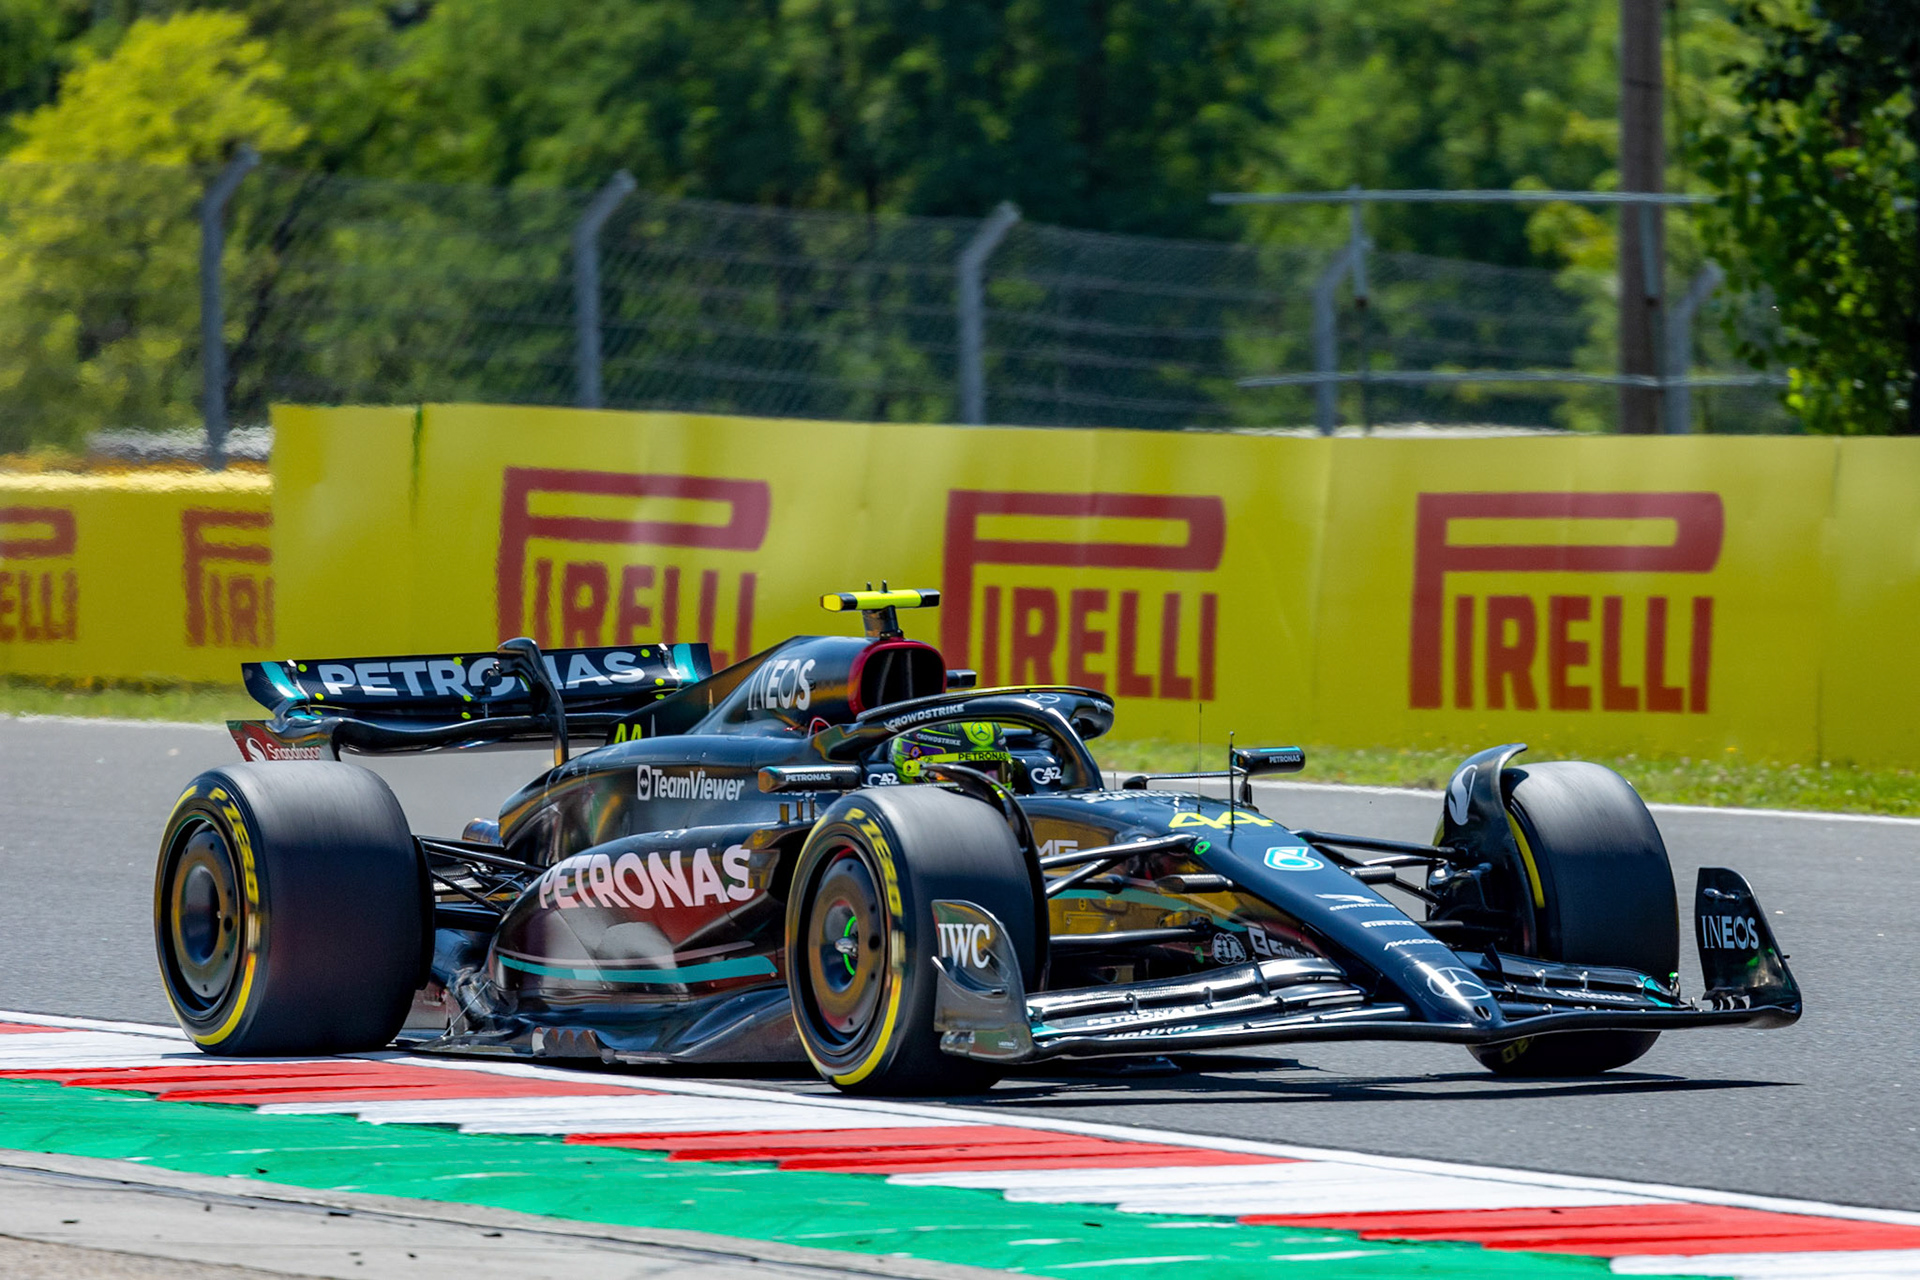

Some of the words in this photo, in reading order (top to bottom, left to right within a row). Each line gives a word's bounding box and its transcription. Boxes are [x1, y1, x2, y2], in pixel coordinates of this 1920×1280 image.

[496, 466, 771, 675] PIRELLI
[940, 489, 1226, 701] PIRELLI
[1409, 491, 1725, 713] PIRELLI
[747, 658, 816, 711] INEOS
[888, 703, 965, 729] CROWDSTRIKE
[916, 733, 961, 747] CROWDSTRIKE
[958, 751, 1007, 762] PETRONAS
[1268, 754, 1301, 764] PETRONAS
[651, 769, 746, 802] TeamViewer
[785, 773, 832, 783] PETRONAS
[1168, 811, 1275, 830] 44
[538, 845, 756, 910] PETRONAS
[938, 923, 991, 968] IWC
[1701, 915, 1760, 950] INEOS
[1086, 1006, 1197, 1026] PETRONAS
